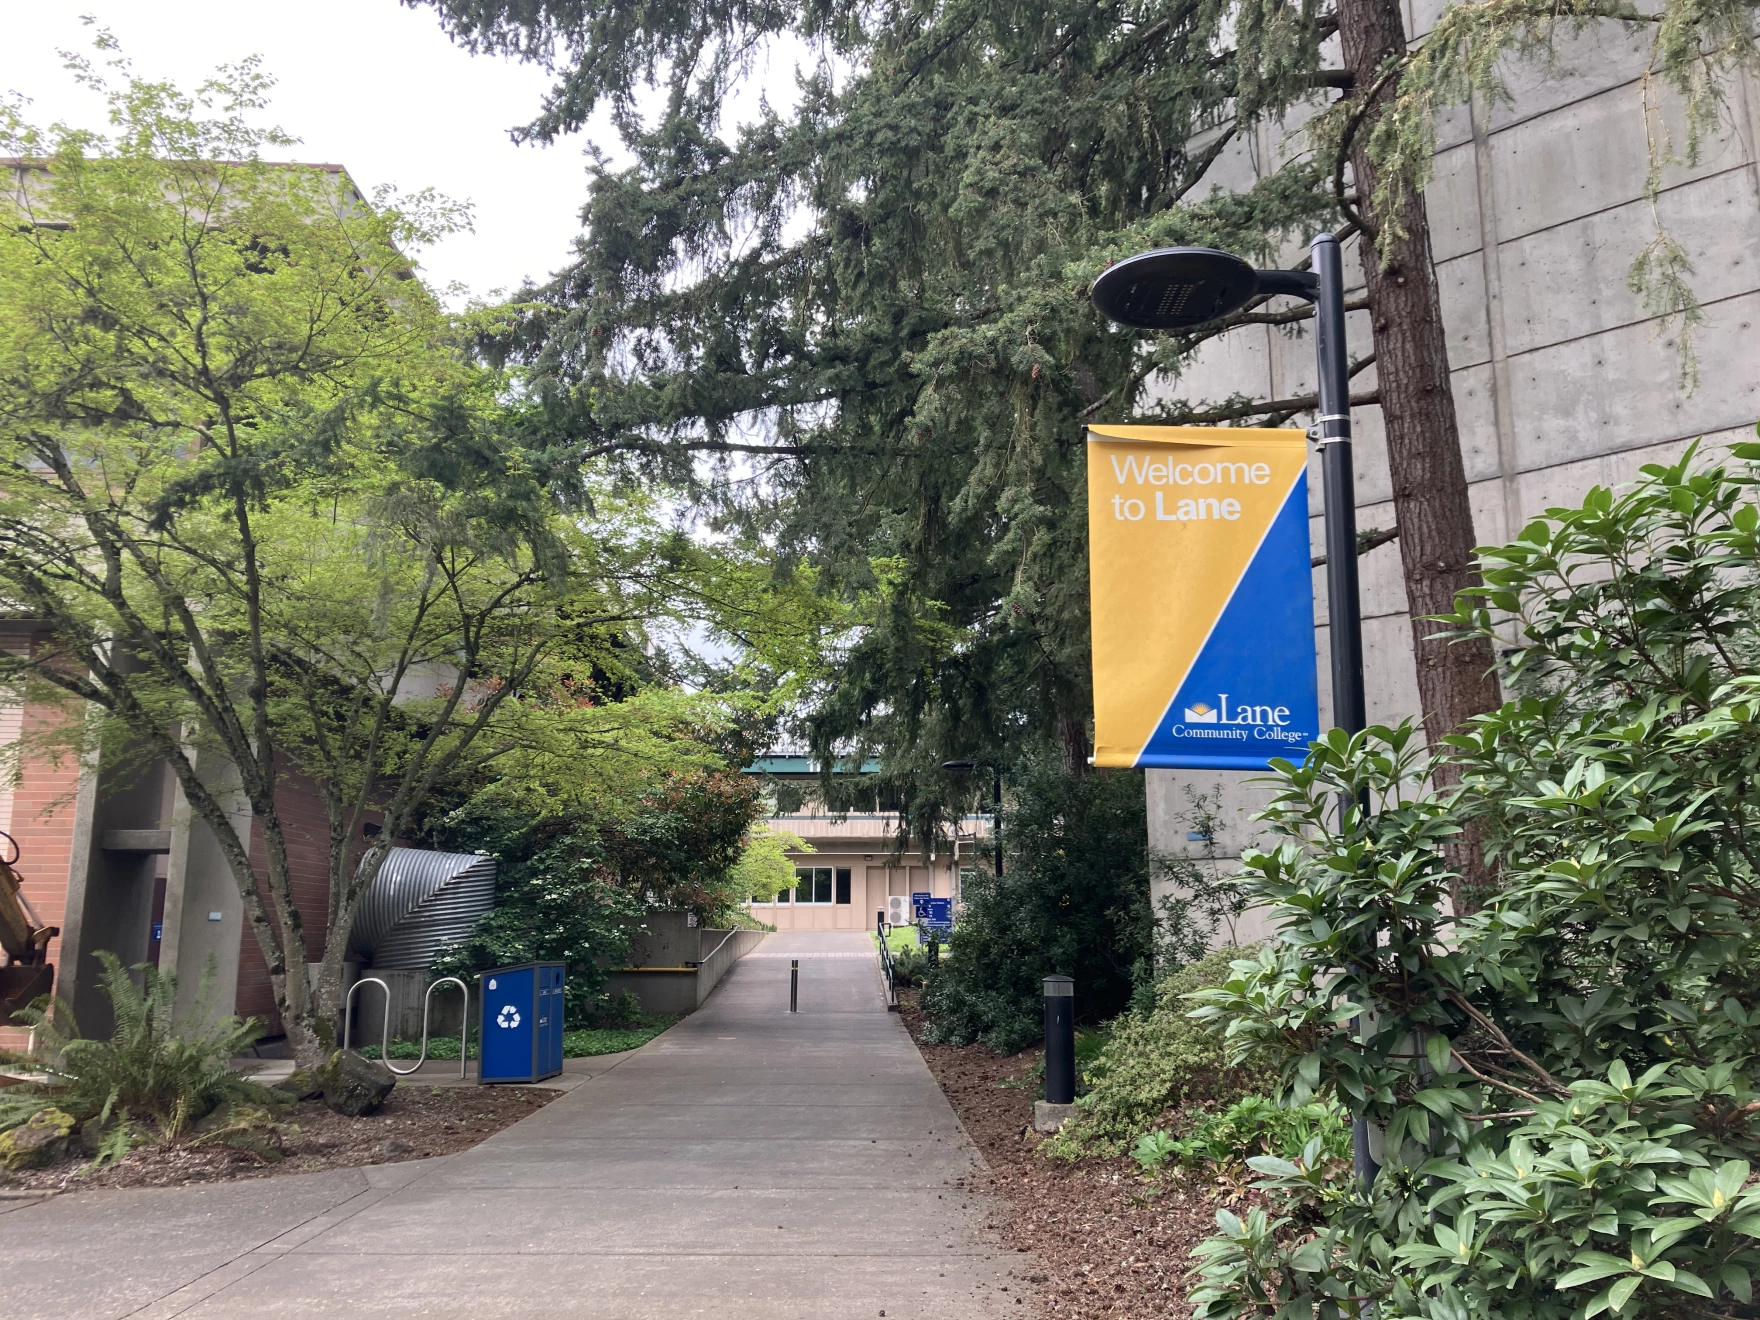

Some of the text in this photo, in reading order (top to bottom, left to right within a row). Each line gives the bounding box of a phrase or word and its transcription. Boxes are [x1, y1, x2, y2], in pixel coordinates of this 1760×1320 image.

[1110, 454, 1271, 485] Welcome
[1111, 491, 1242, 521] to Lane
[1217, 693, 1291, 726] Lane
[1172, 724, 1302, 744] Community College
